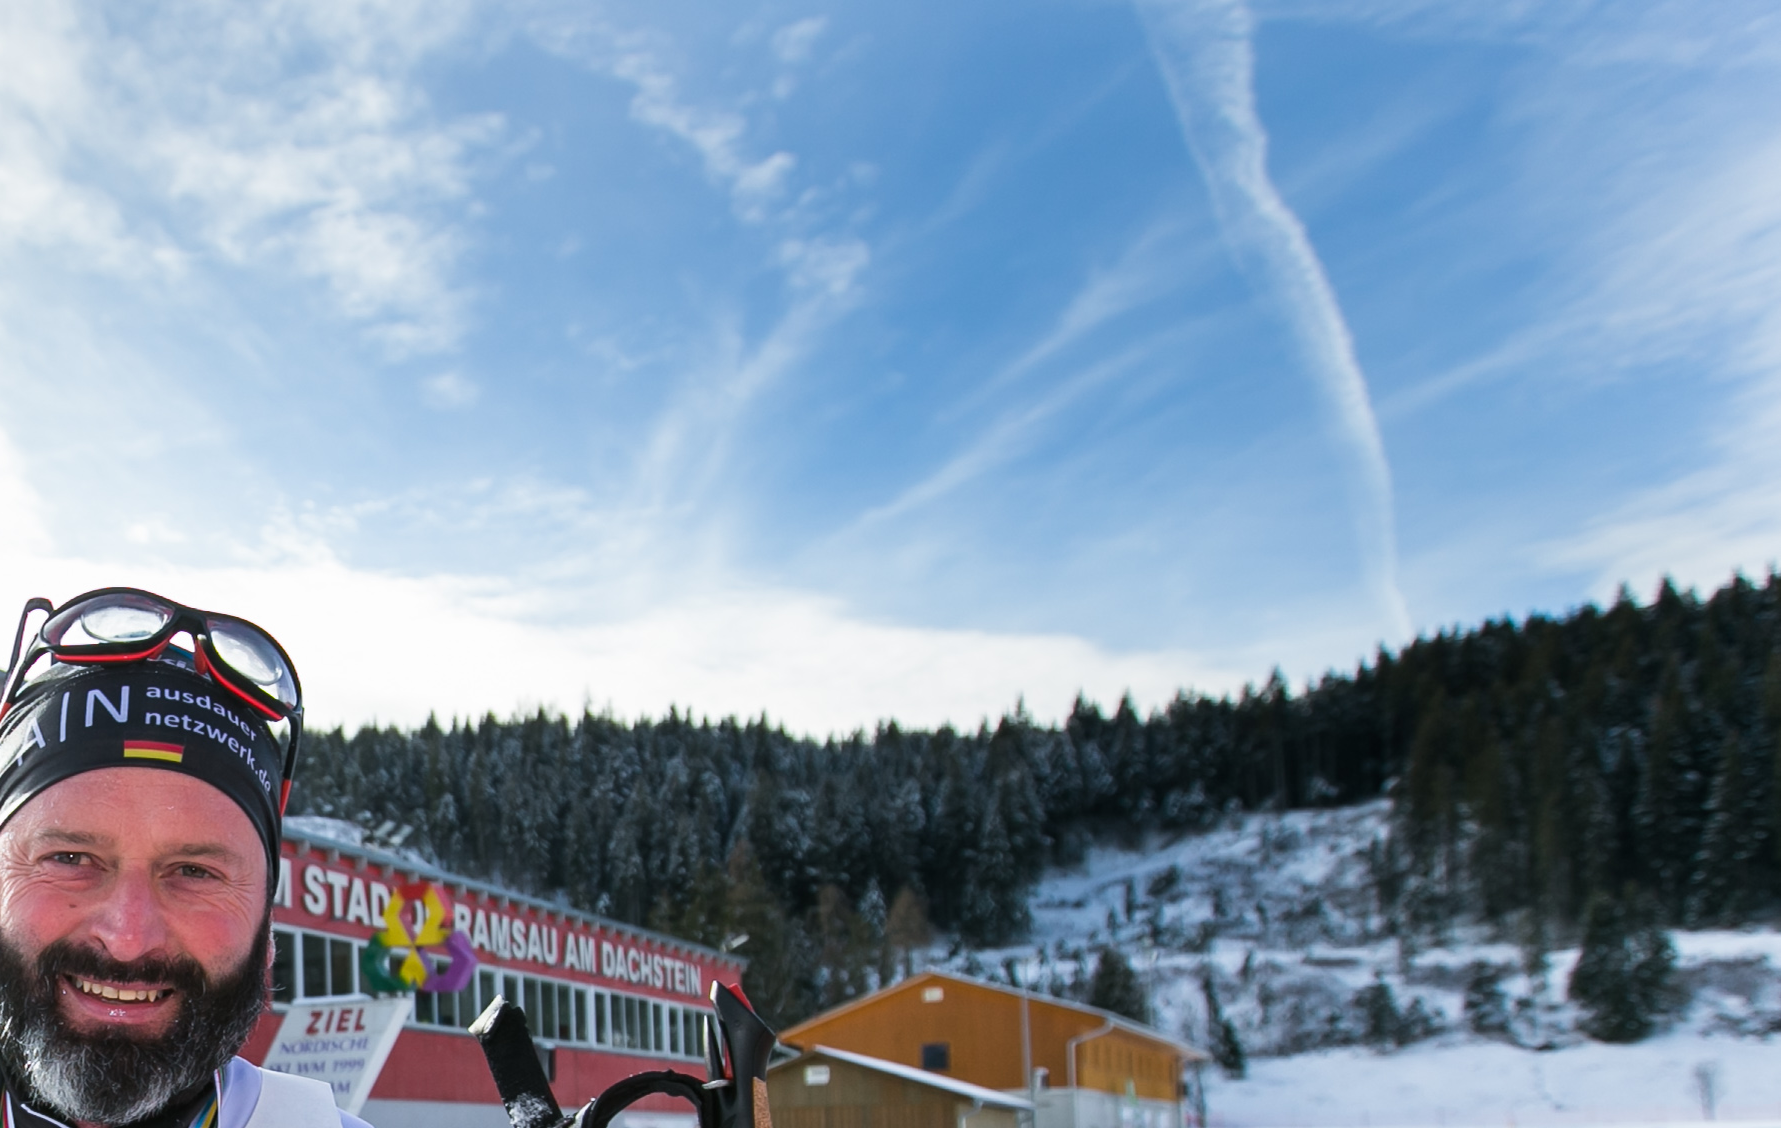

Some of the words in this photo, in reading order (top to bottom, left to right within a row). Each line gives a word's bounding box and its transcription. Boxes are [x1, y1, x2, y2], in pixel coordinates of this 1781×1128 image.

[145, 685, 257, 742] ausdauer
[303, 864, 430, 936] STAD
[454, 903, 558, 966] RAMSAU
[564, 932, 597, 974] AM
[601, 942, 703, 996] DACHSTEIN
[305, 1007, 367, 1035] ZIEL
